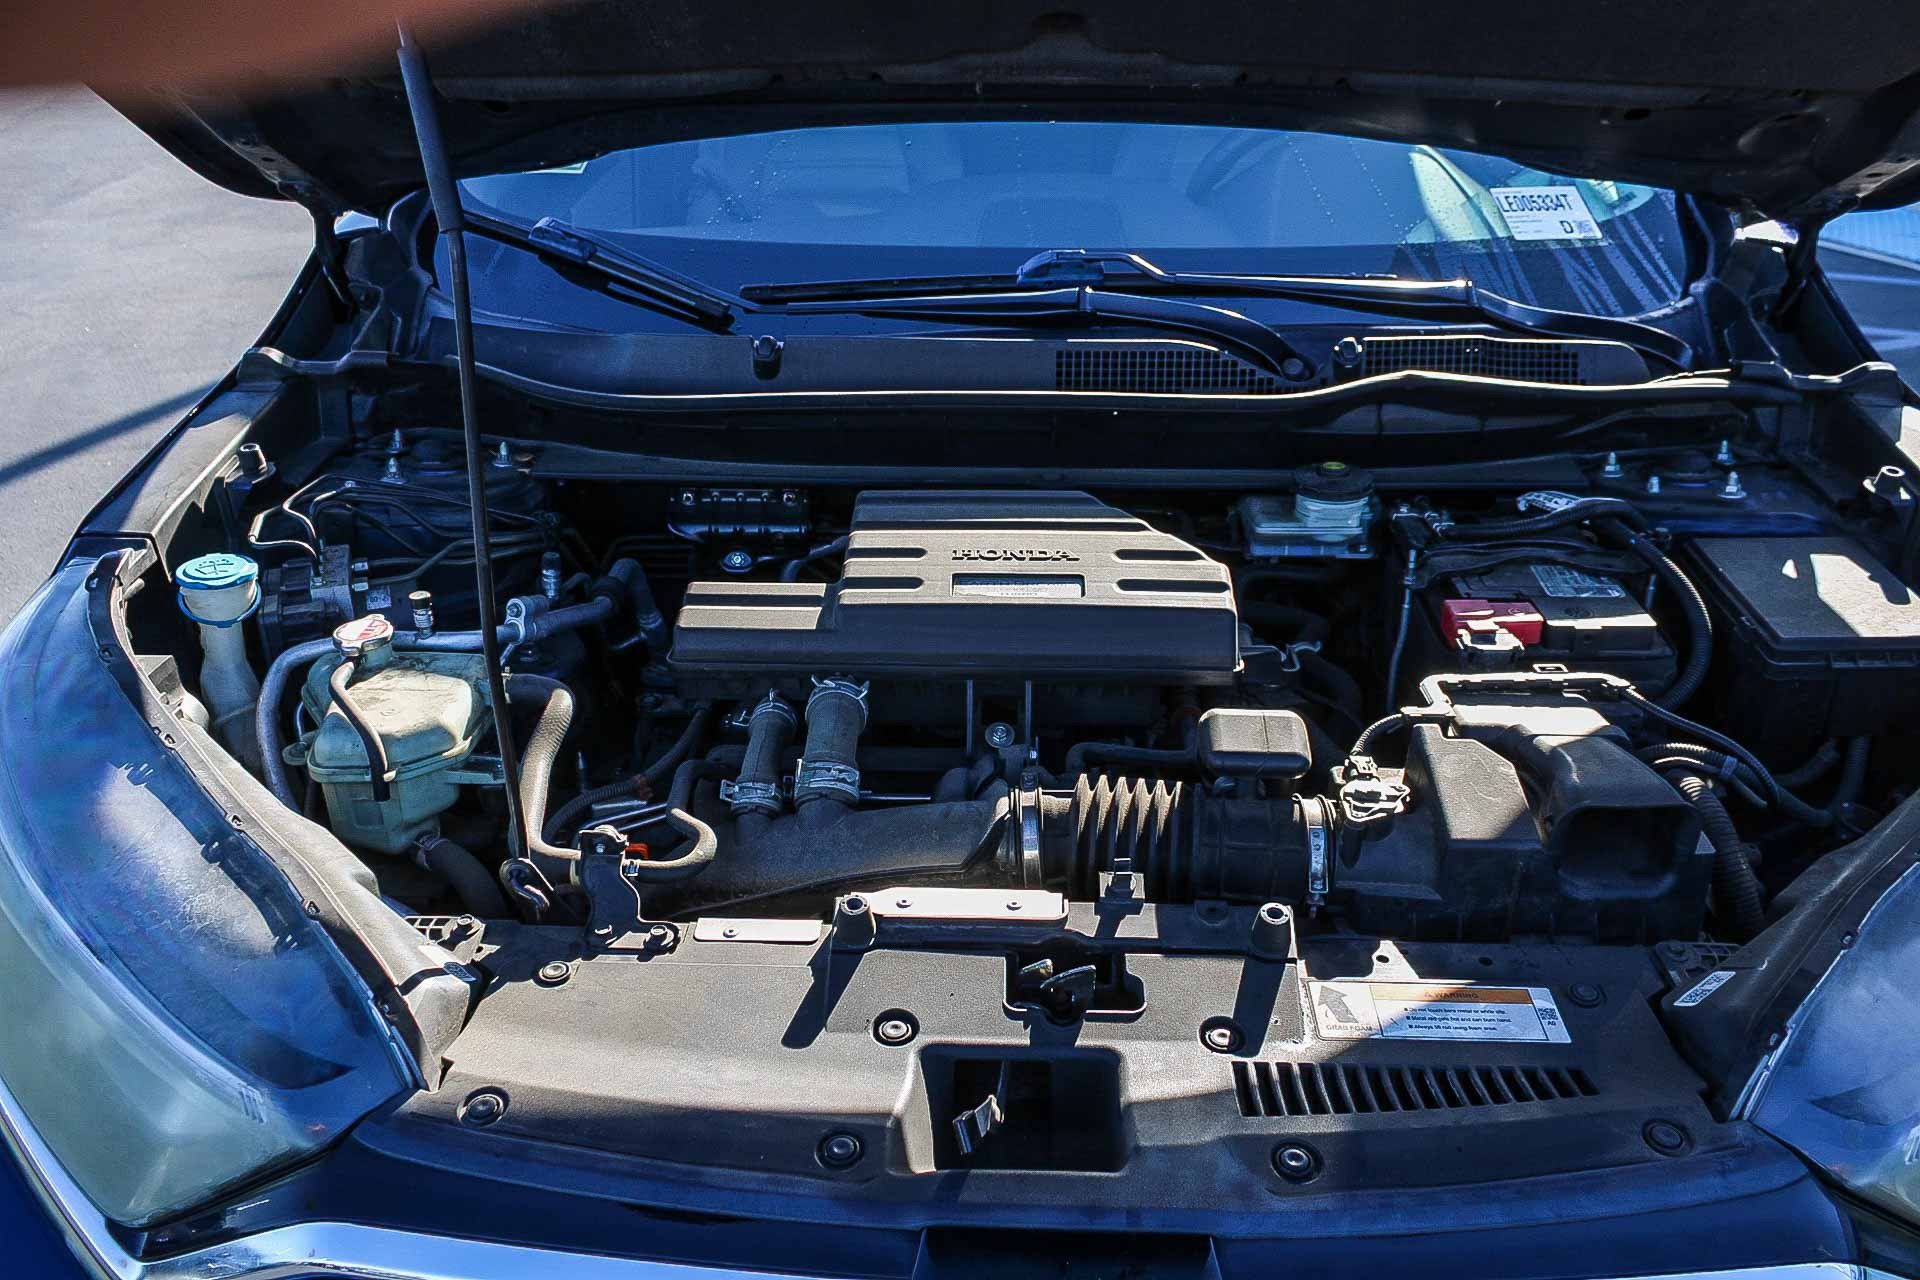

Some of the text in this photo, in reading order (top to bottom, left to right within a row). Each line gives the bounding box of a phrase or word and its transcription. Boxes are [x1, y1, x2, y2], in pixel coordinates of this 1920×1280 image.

[1560, 220, 1574, 234] D
[951, 549, 1080, 561] HONDA
[1436, 991, 1480, 999] WARNING
